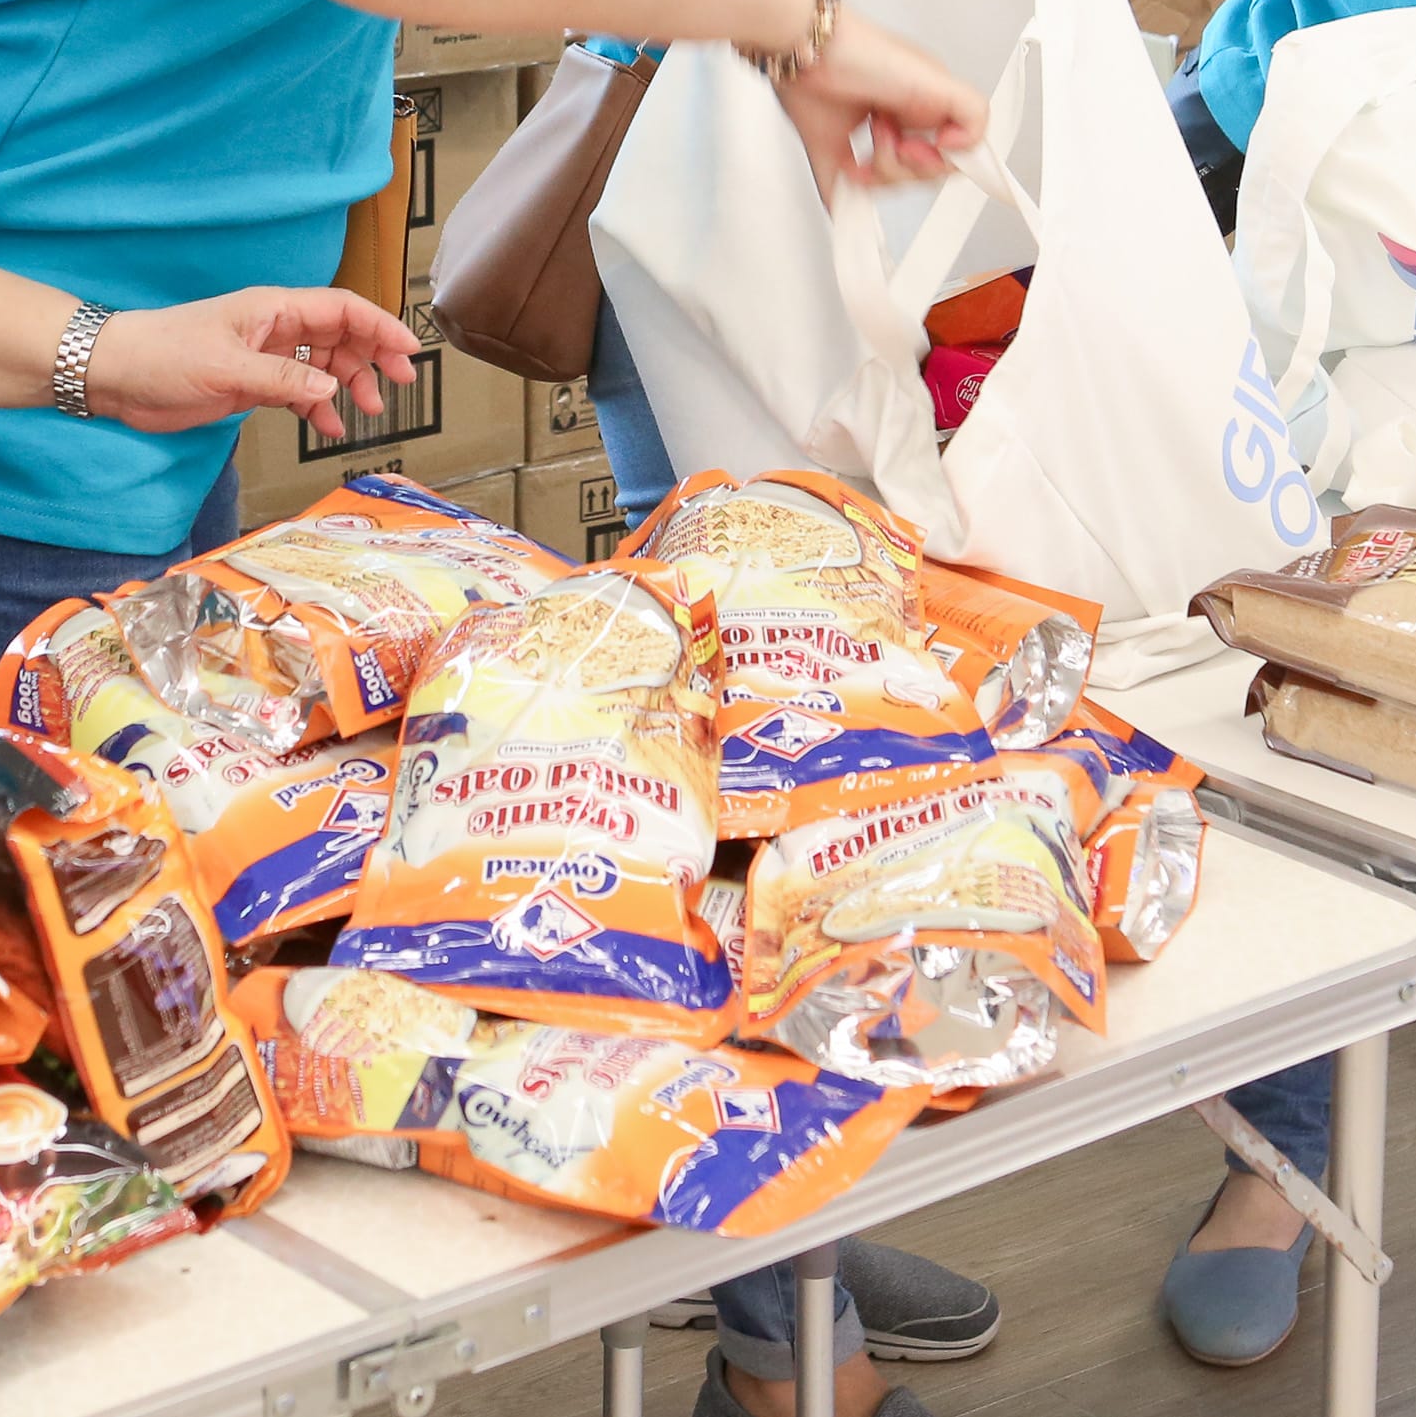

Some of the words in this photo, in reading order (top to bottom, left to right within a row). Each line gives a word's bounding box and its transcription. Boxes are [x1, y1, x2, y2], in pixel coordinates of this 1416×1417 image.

[1223, 338, 1287, 503] GIF
[763, 625, 884, 664] Rolled
[17, 669, 33, 725] 500g
[353, 654, 385, 707] 500g
[271, 756, 389, 812] Cowhead
[432, 763, 536, 805] Oats
[550, 759, 682, 814] Rolled
[471, 792, 638, 842] Organic
[808, 801, 946, 879] Rolled
[483, 852, 619, 899] Cowhead
